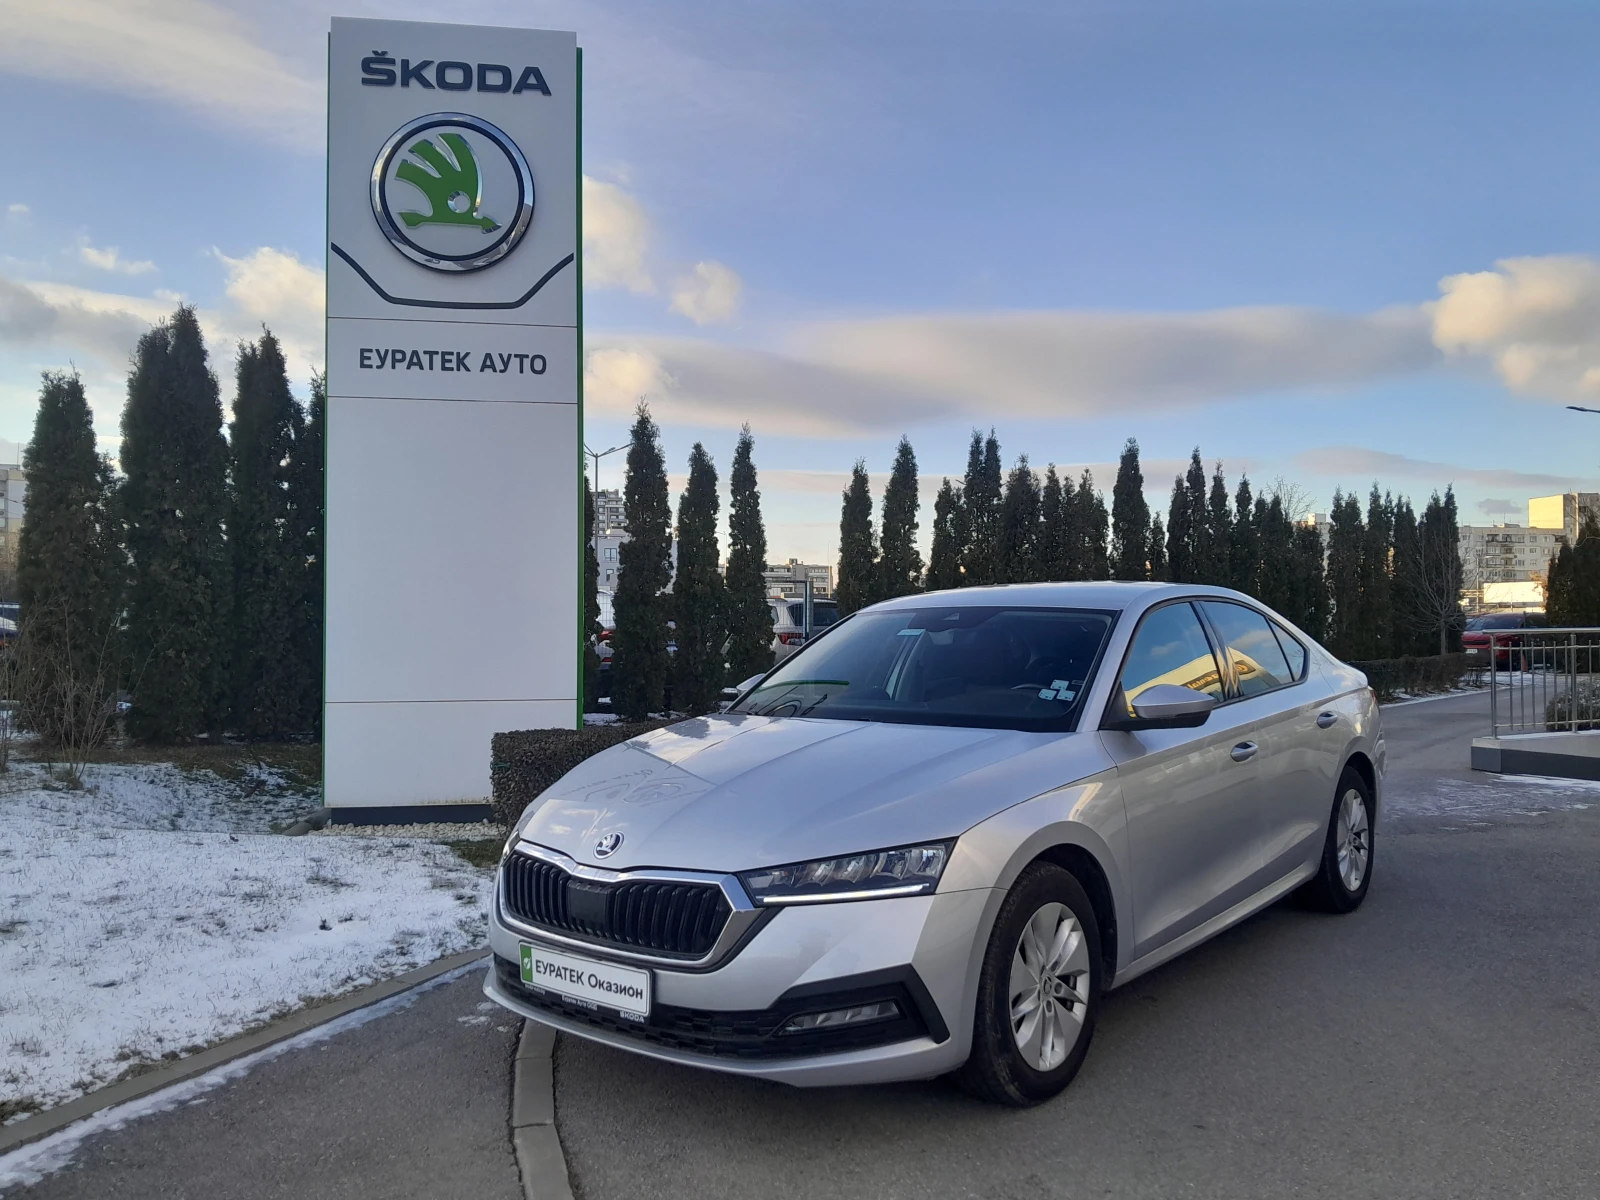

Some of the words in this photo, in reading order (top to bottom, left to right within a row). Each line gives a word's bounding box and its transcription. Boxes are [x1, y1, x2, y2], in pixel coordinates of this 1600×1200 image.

[361, 50, 552, 96] ŠKODA
[359, 348, 471, 372] ЕУРАТЕК
[479, 352, 547, 375] АУТО
[535, 959, 585, 986] ЕУРАТЕК
[588, 973, 643, 1000] Оказион
